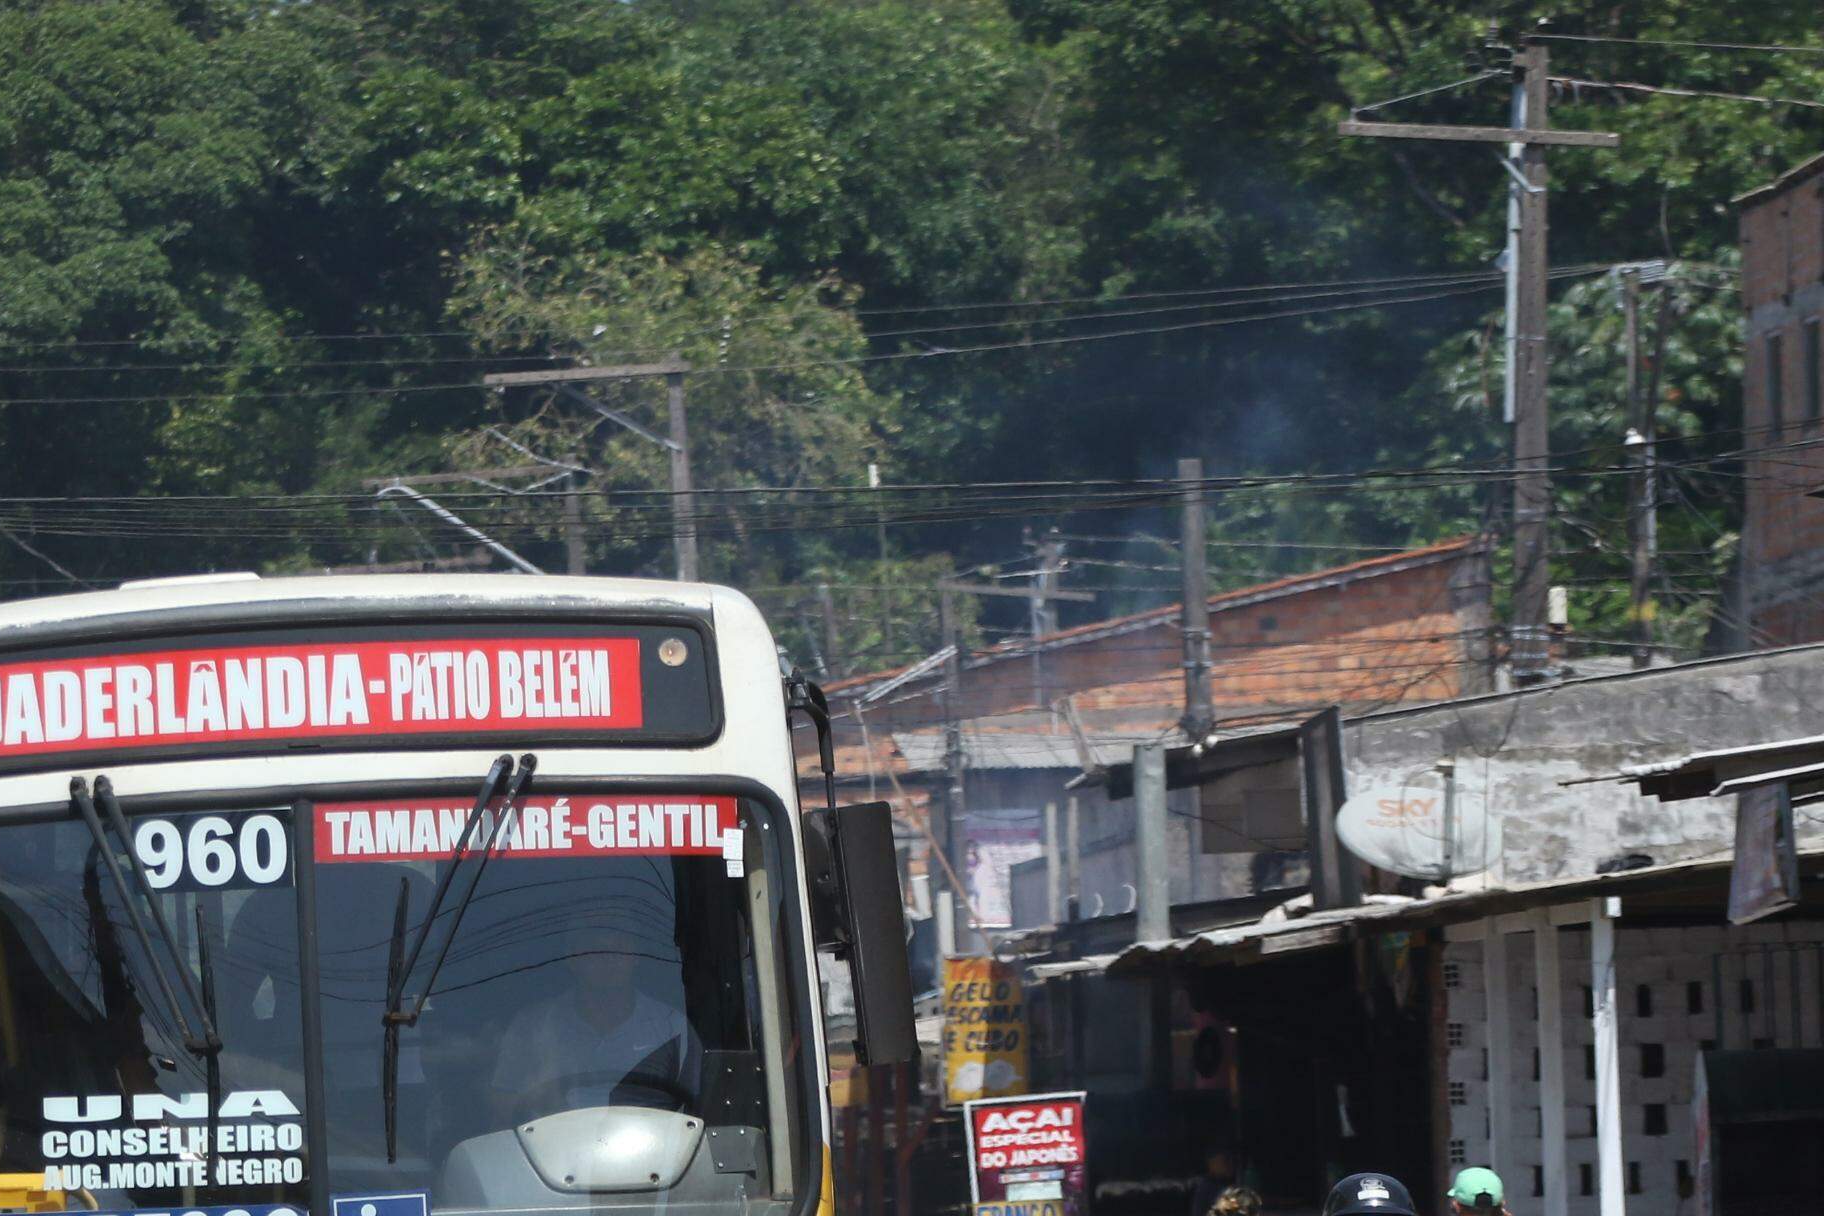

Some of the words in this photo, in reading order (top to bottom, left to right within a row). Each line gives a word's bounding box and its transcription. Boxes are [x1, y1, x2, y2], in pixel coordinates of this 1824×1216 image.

[497, 650, 611, 719] BELÉM
[1377, 798, 1439, 817] SKY
[135, 814, 287, 889] 960
[952, 982, 1010, 1001] GELO
[43, 1090, 301, 1122] UNA
[42, 1123, 303, 1158] CONSELHEIRO
[980, 1130, 1076, 1148] ESPECIAL
[980, 1151, 1008, 1168] DO
